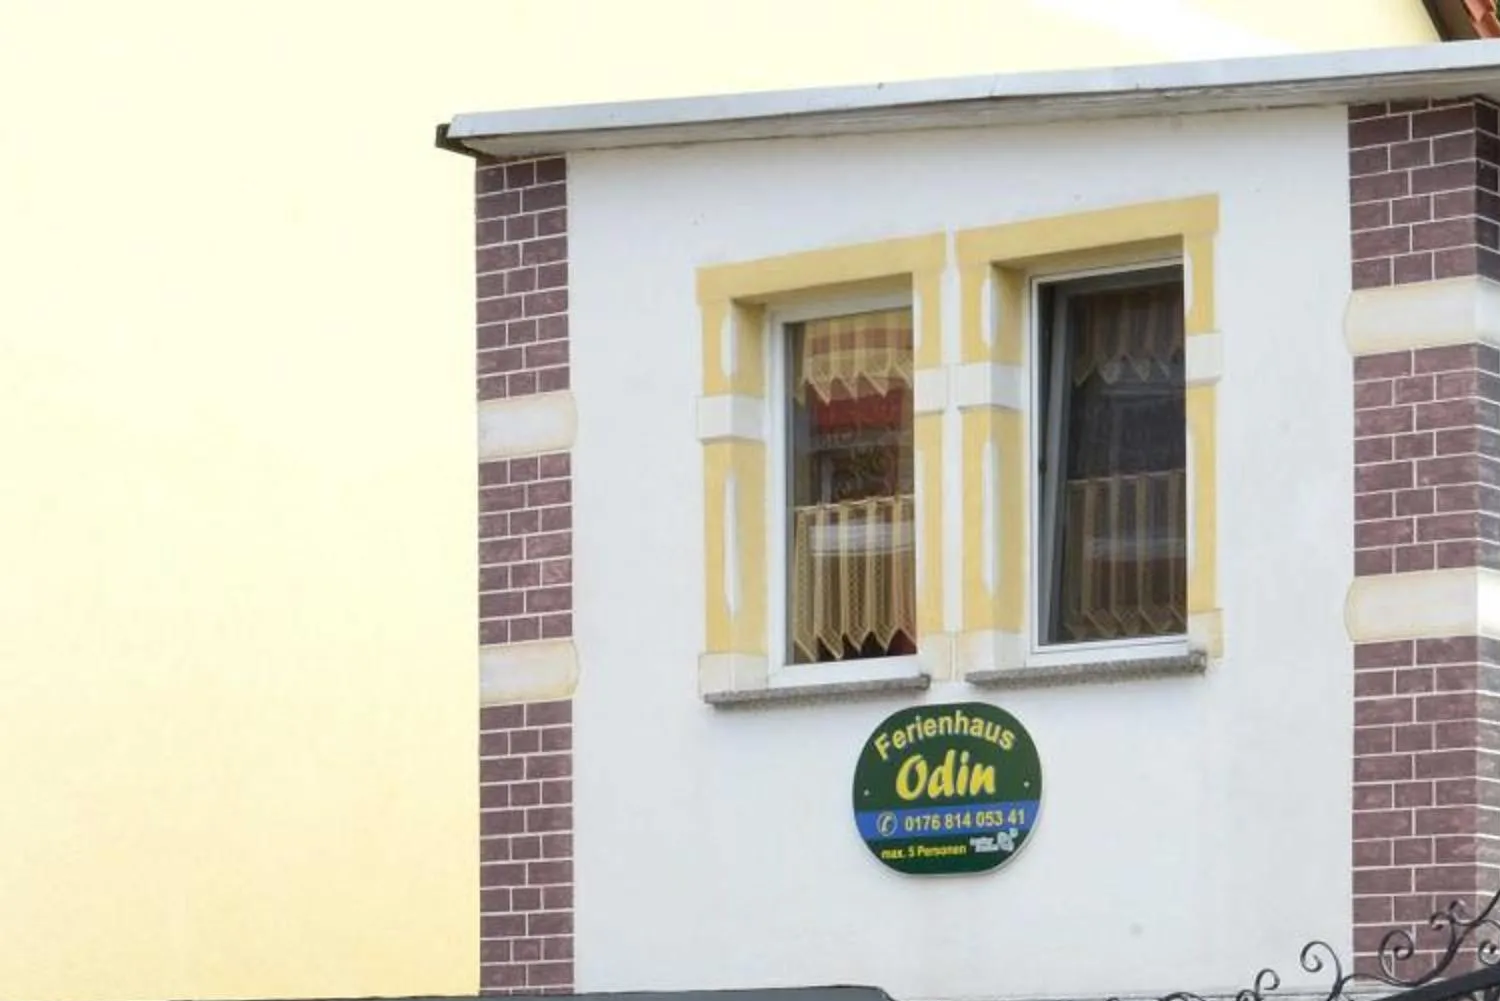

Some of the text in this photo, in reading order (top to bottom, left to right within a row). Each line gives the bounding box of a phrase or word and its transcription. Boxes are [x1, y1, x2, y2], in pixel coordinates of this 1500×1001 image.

[875, 710, 1016, 760] Ferienhaus
[895, 749, 996, 800] Odin
[905, 808, 1025, 832] 0176 814 053 41
[917, 844, 967, 857] Personen
